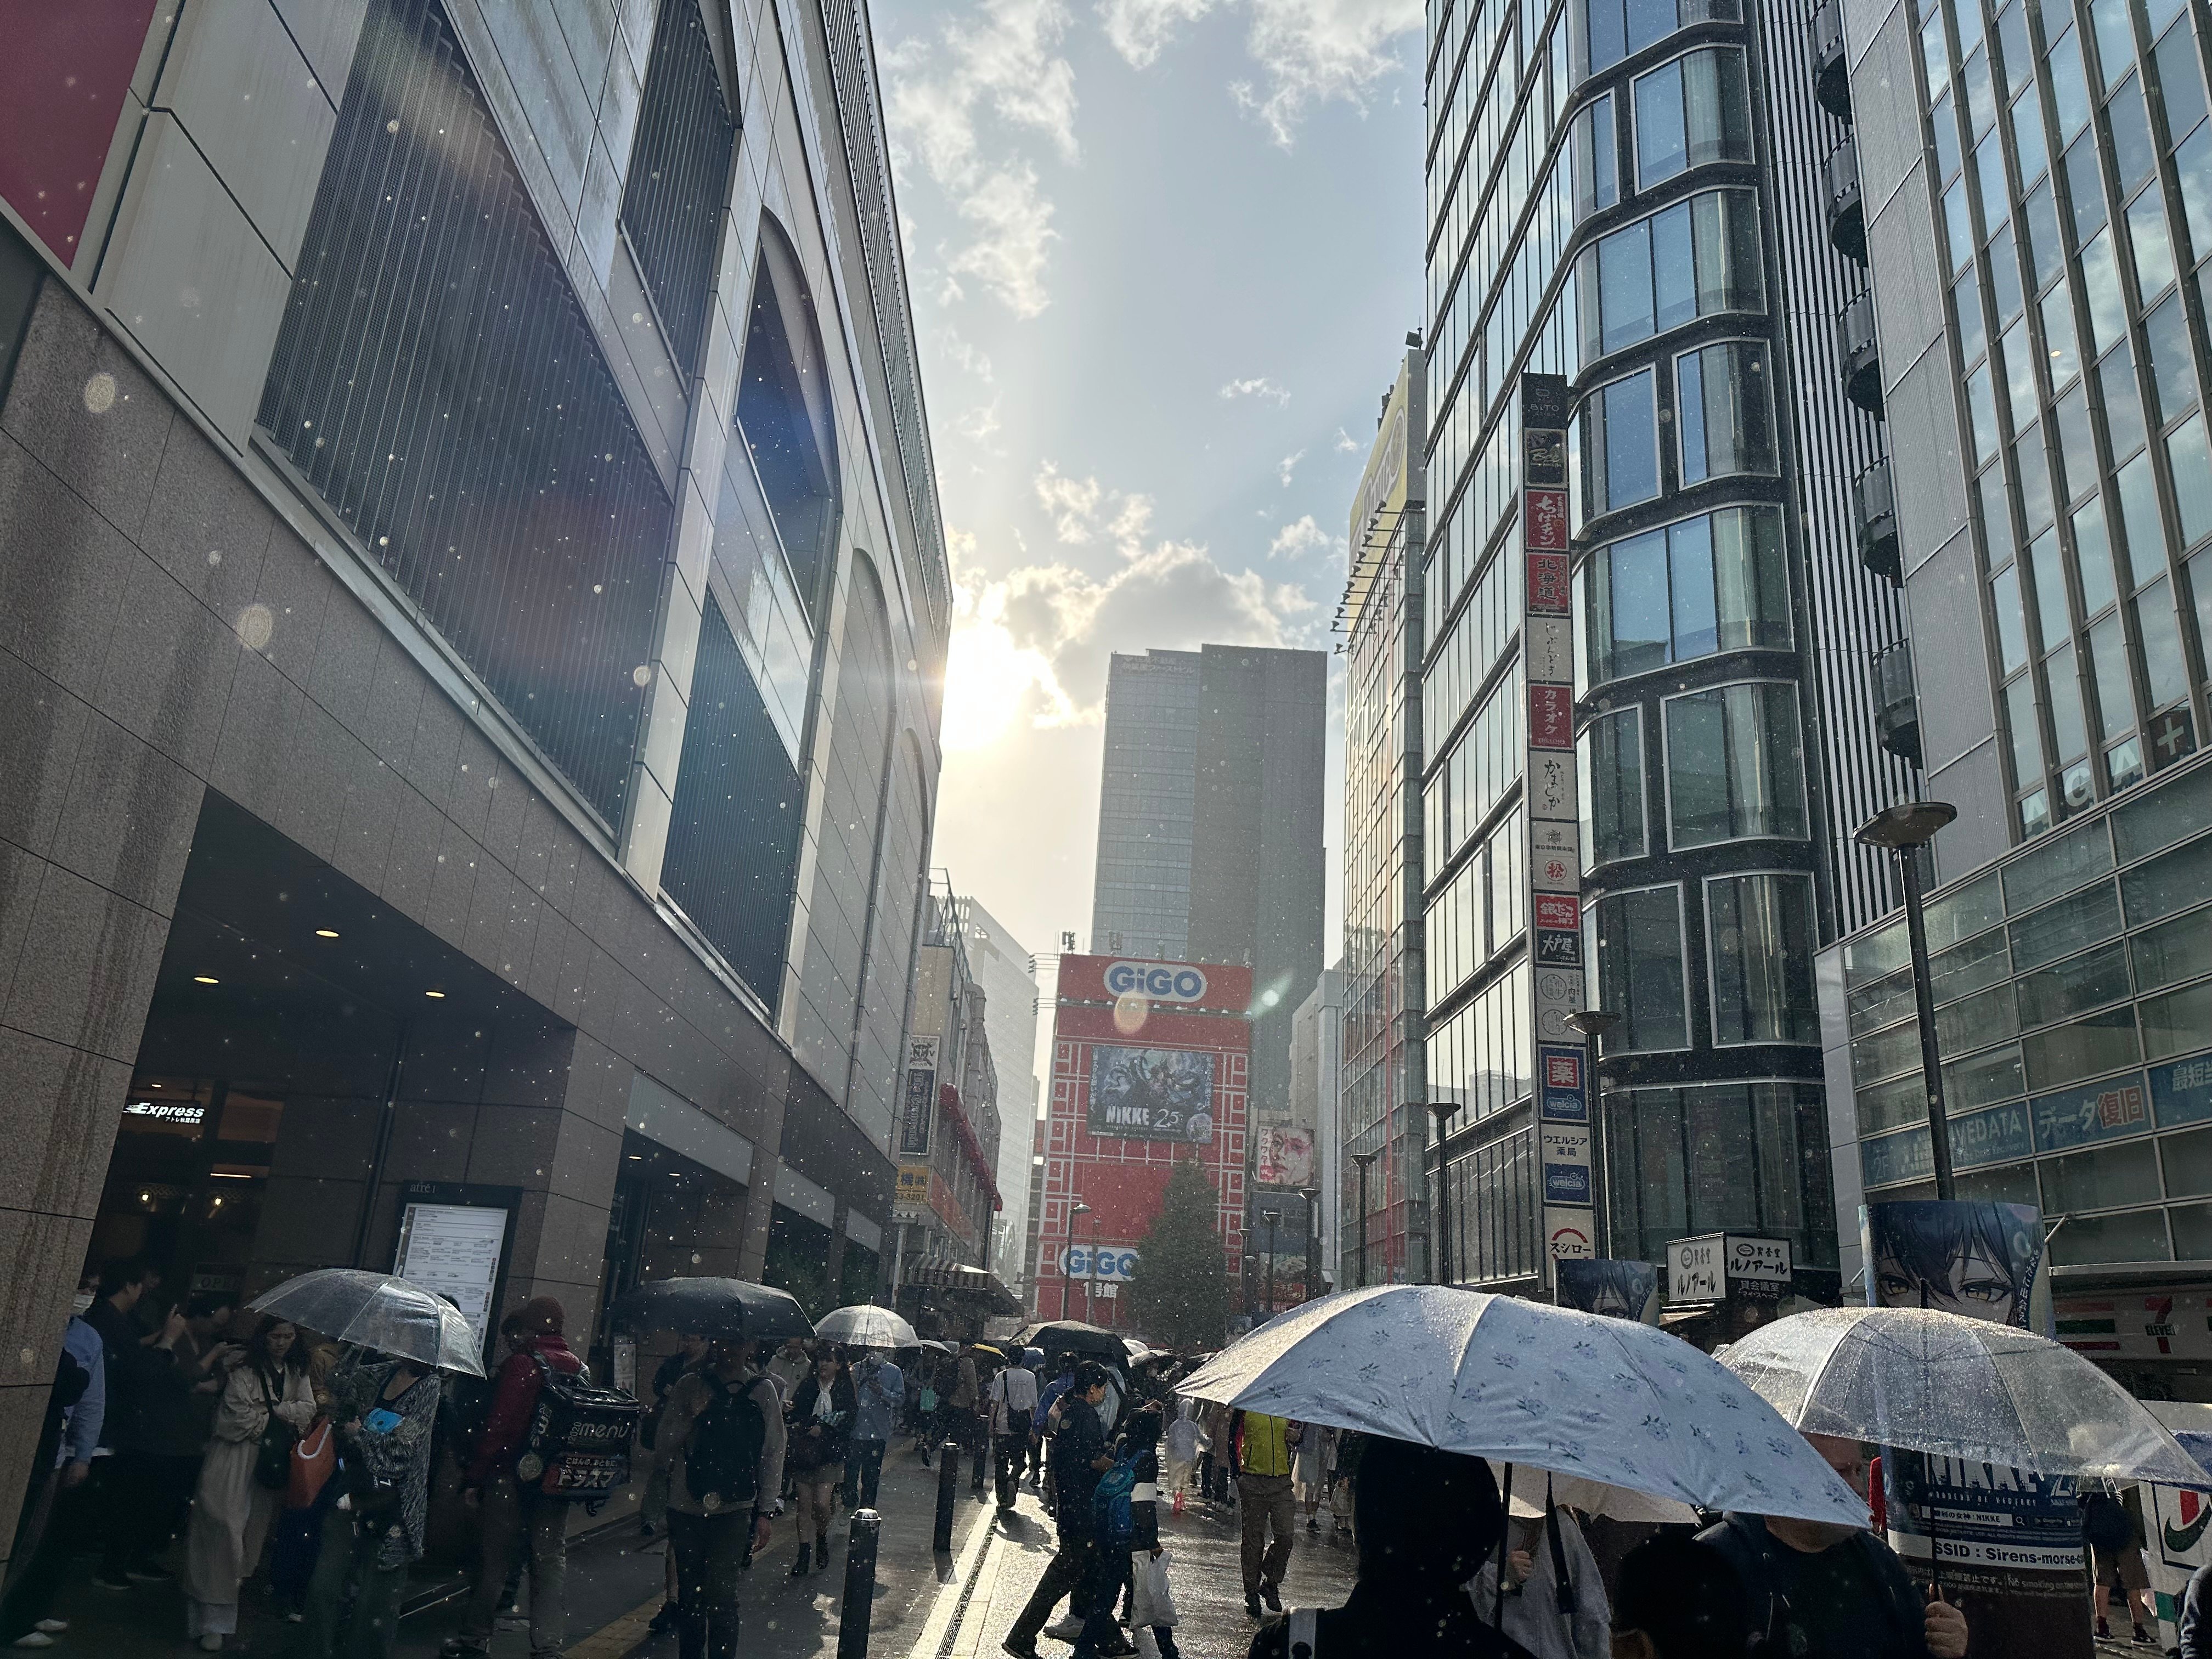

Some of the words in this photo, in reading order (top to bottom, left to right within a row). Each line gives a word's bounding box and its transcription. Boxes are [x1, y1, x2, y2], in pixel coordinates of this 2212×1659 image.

[1538, 558, 1559, 600] 北海道
[1545, 690, 1559, 735] カラオケ
[1544, 759, 1561, 811] かまどか
[1542, 934, 1575, 955] 大戸屋
[1109, 966, 1202, 997] GiGO
[1551, 1062, 1575, 1084] 薬
[131, 1102, 205, 1118] Express
[1549, 1099, 1578, 1109] welcia
[2038, 1085, 2146, 1139] データ復旧
[1105, 1105, 1150, 1126] NIKKE
[1544, 1135, 1588, 1146] ウエルシア
[1556, 1146, 1577, 1157] 薬局
[1551, 1178, 1582, 1188] welcia
[1549, 1243, 1592, 1256] スシロー
[1757, 1246, 1781, 1258] 喫茶室
[1730, 1258, 1788, 1275] ルノアール
[1677, 1270, 1717, 1296] ルノアール
[578, 1423, 630, 1438] menu
[1935, 1542, 1971, 1558] SSID
